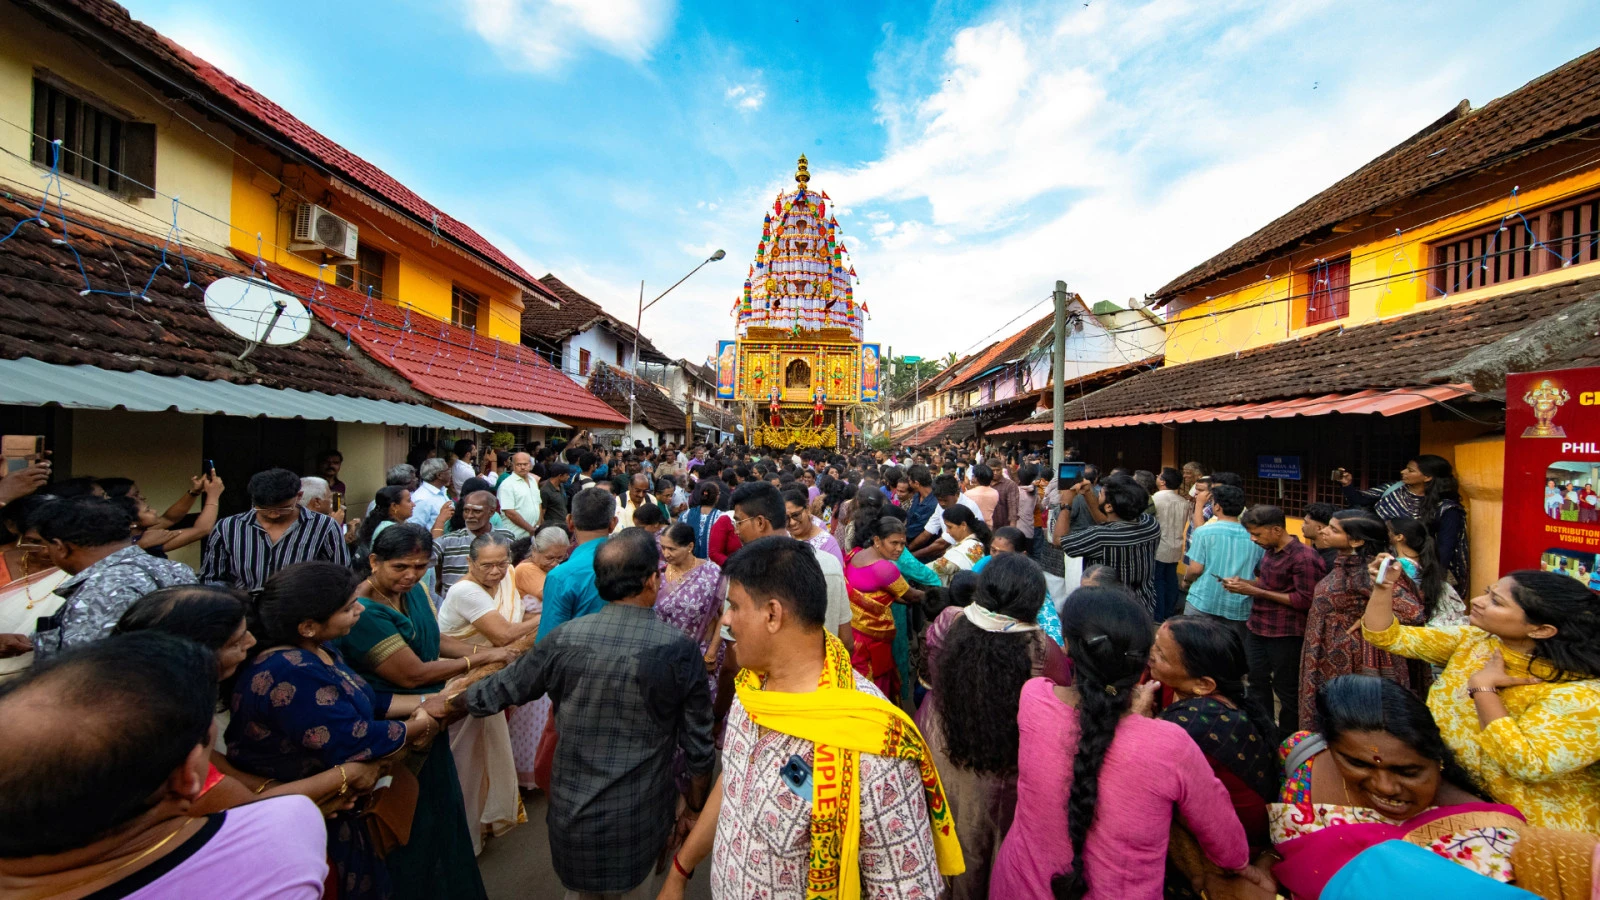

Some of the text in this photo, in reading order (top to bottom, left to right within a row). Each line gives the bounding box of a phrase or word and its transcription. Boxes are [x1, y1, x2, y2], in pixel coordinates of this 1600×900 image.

[1562, 442, 1600, 453] PHIL
[1545, 524, 1600, 538] DISTRIBUTION
[1559, 534, 1600, 545] VISHU KIT
